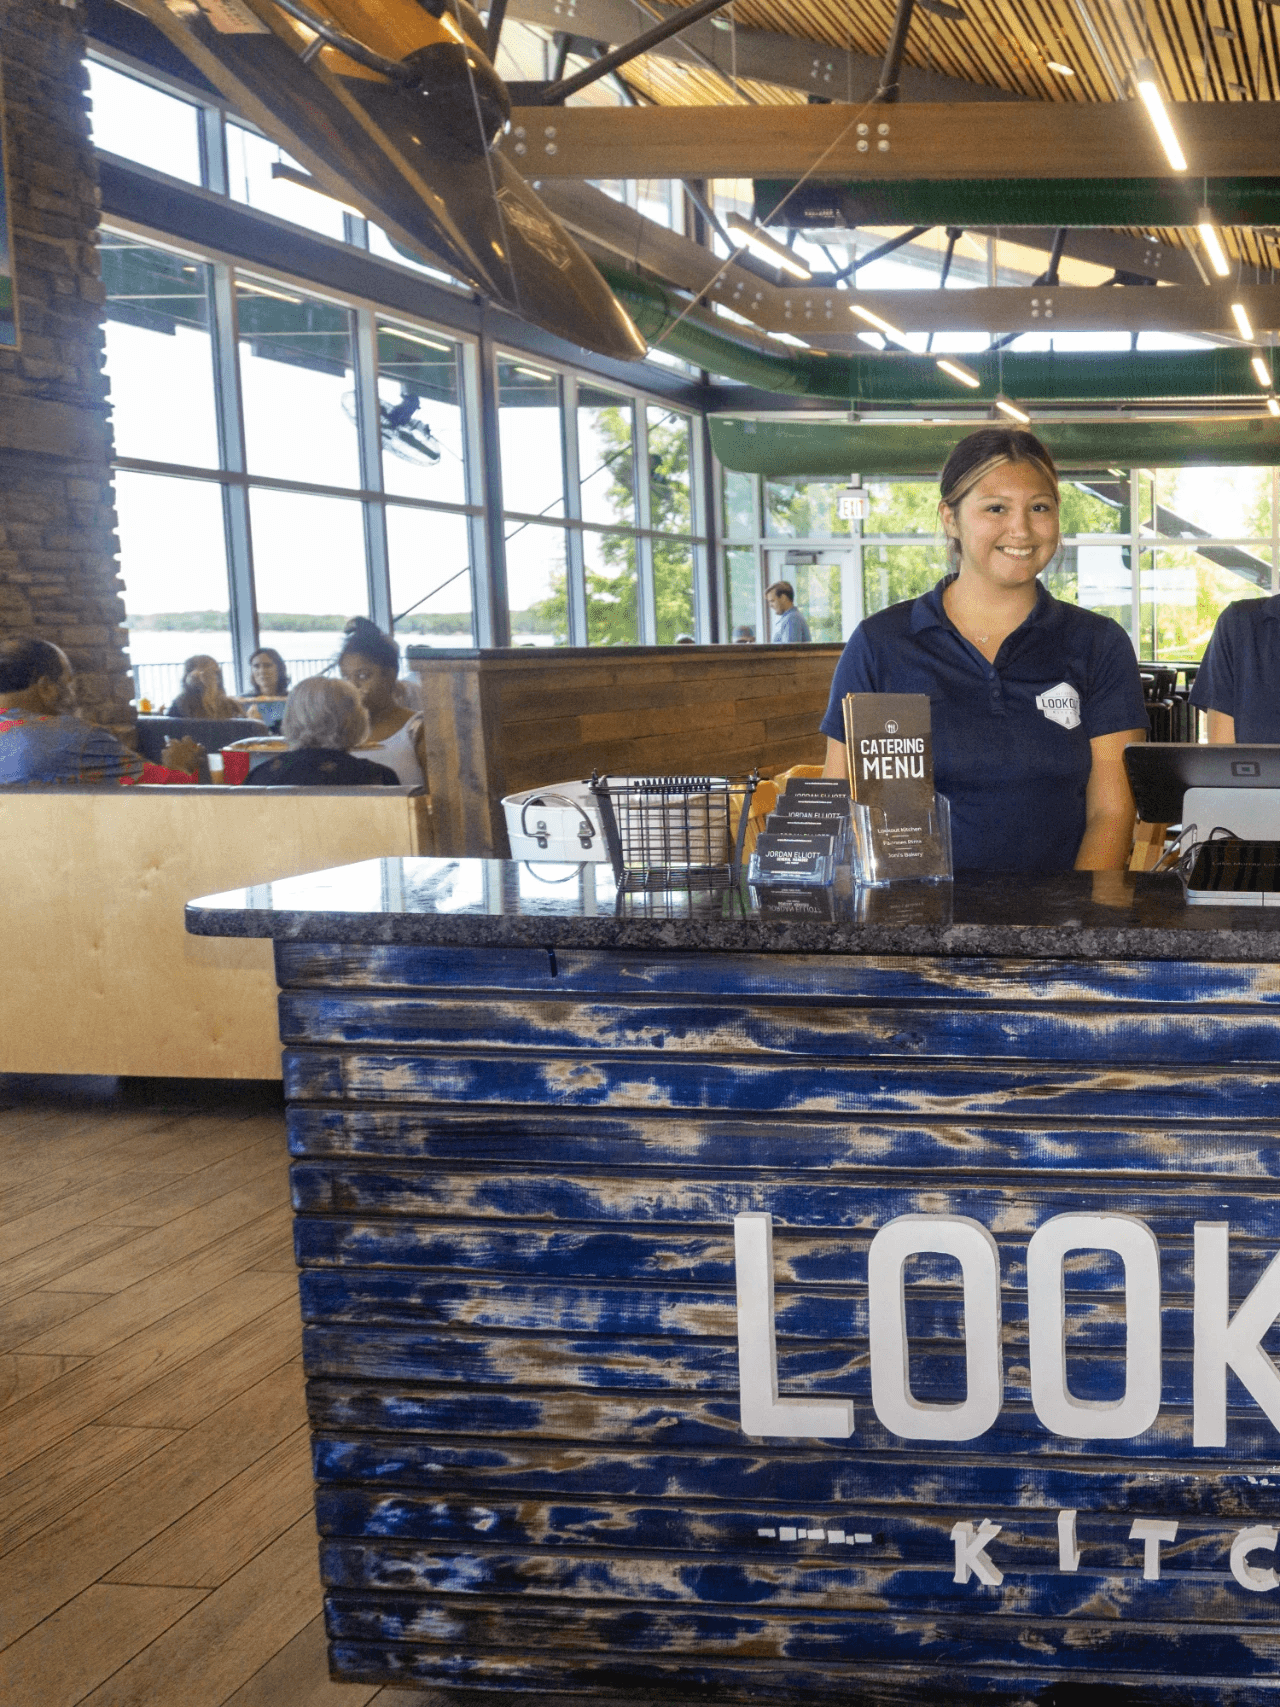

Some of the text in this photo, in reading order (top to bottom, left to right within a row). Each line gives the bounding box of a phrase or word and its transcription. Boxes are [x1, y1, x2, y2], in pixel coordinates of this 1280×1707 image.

[844, 500, 864, 517] EXIT
[860, 738, 925, 755] CATERING
[863, 755, 925, 780] MENU
[793, 851, 820, 859] ELLIOTT
